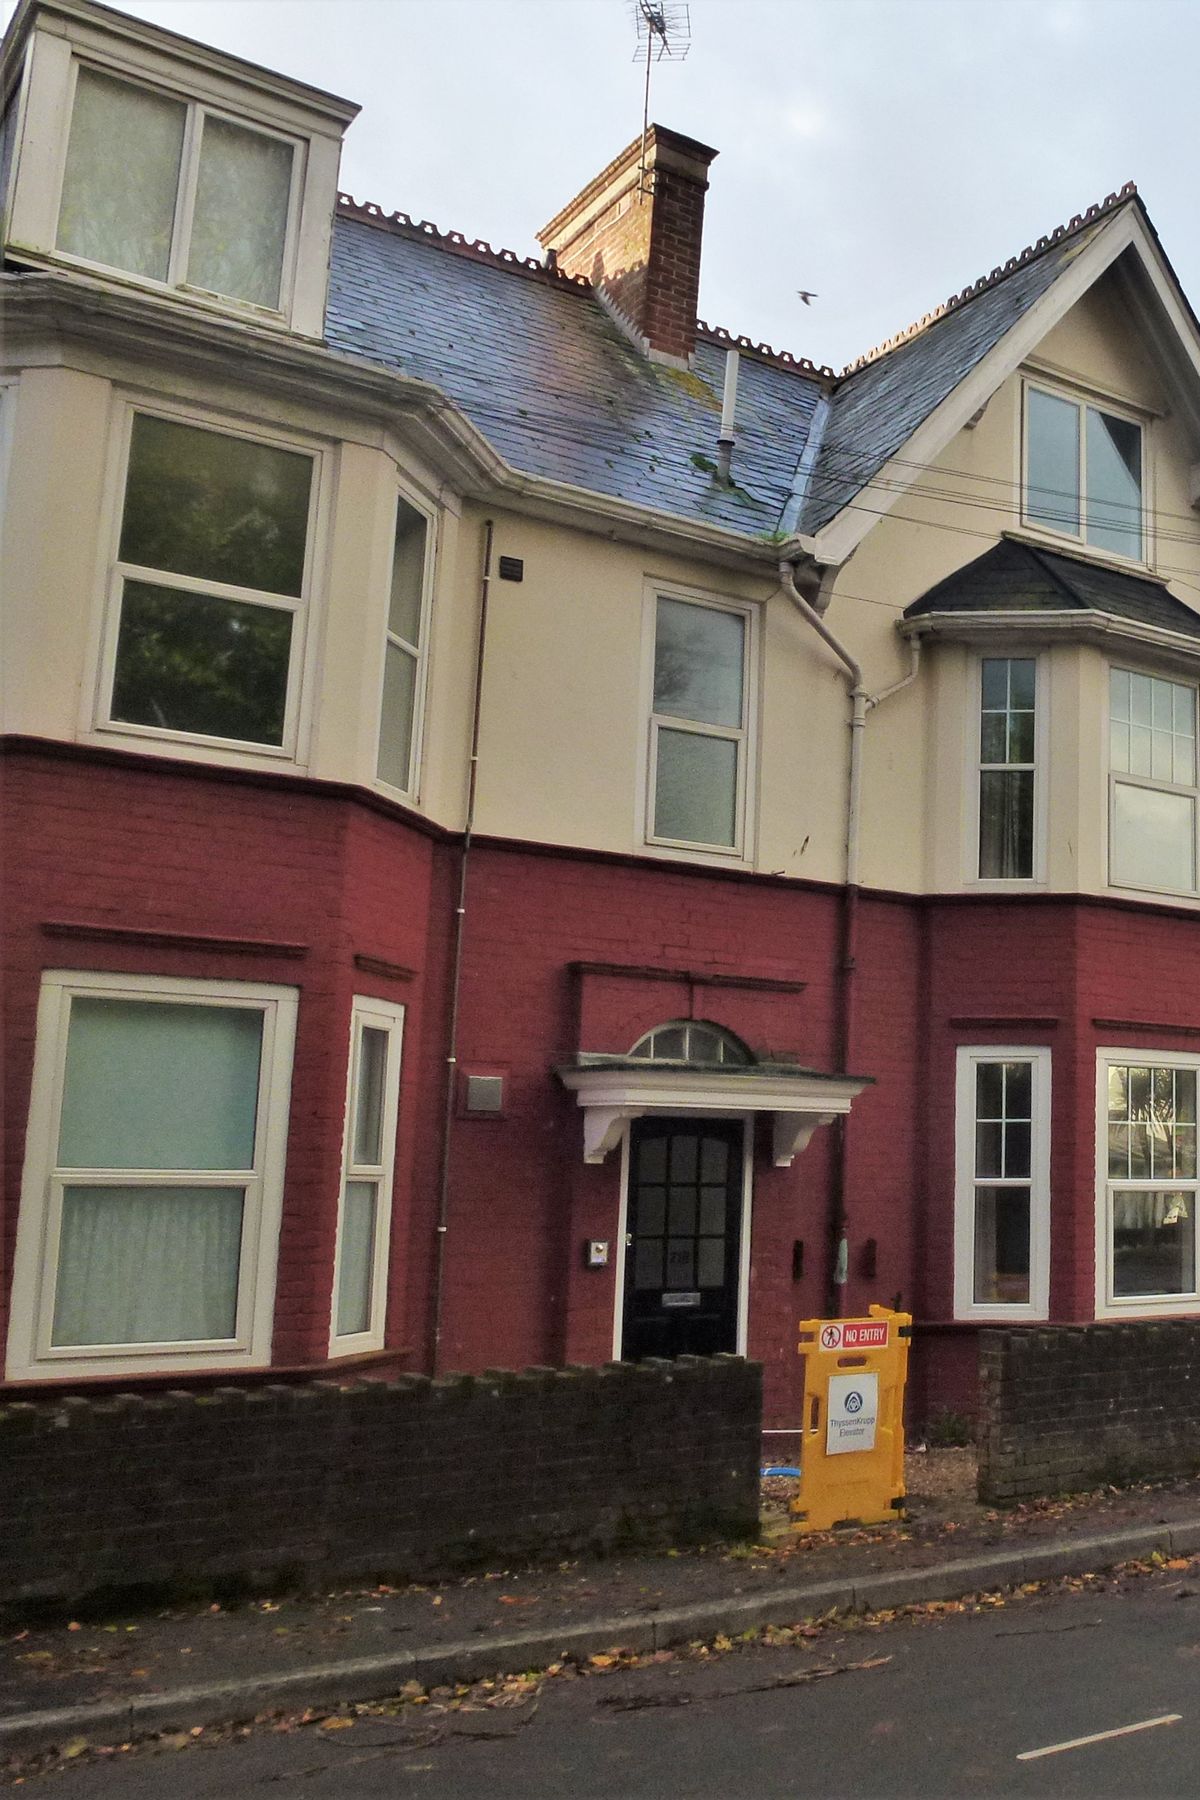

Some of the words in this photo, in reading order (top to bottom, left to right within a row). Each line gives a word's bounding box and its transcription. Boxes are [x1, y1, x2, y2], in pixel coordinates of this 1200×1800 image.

[845, 1329, 858, 1342] NO
[859, 1327, 885, 1341] ENTRY
[830, 1417, 875, 1428] ThyssenKrupp
